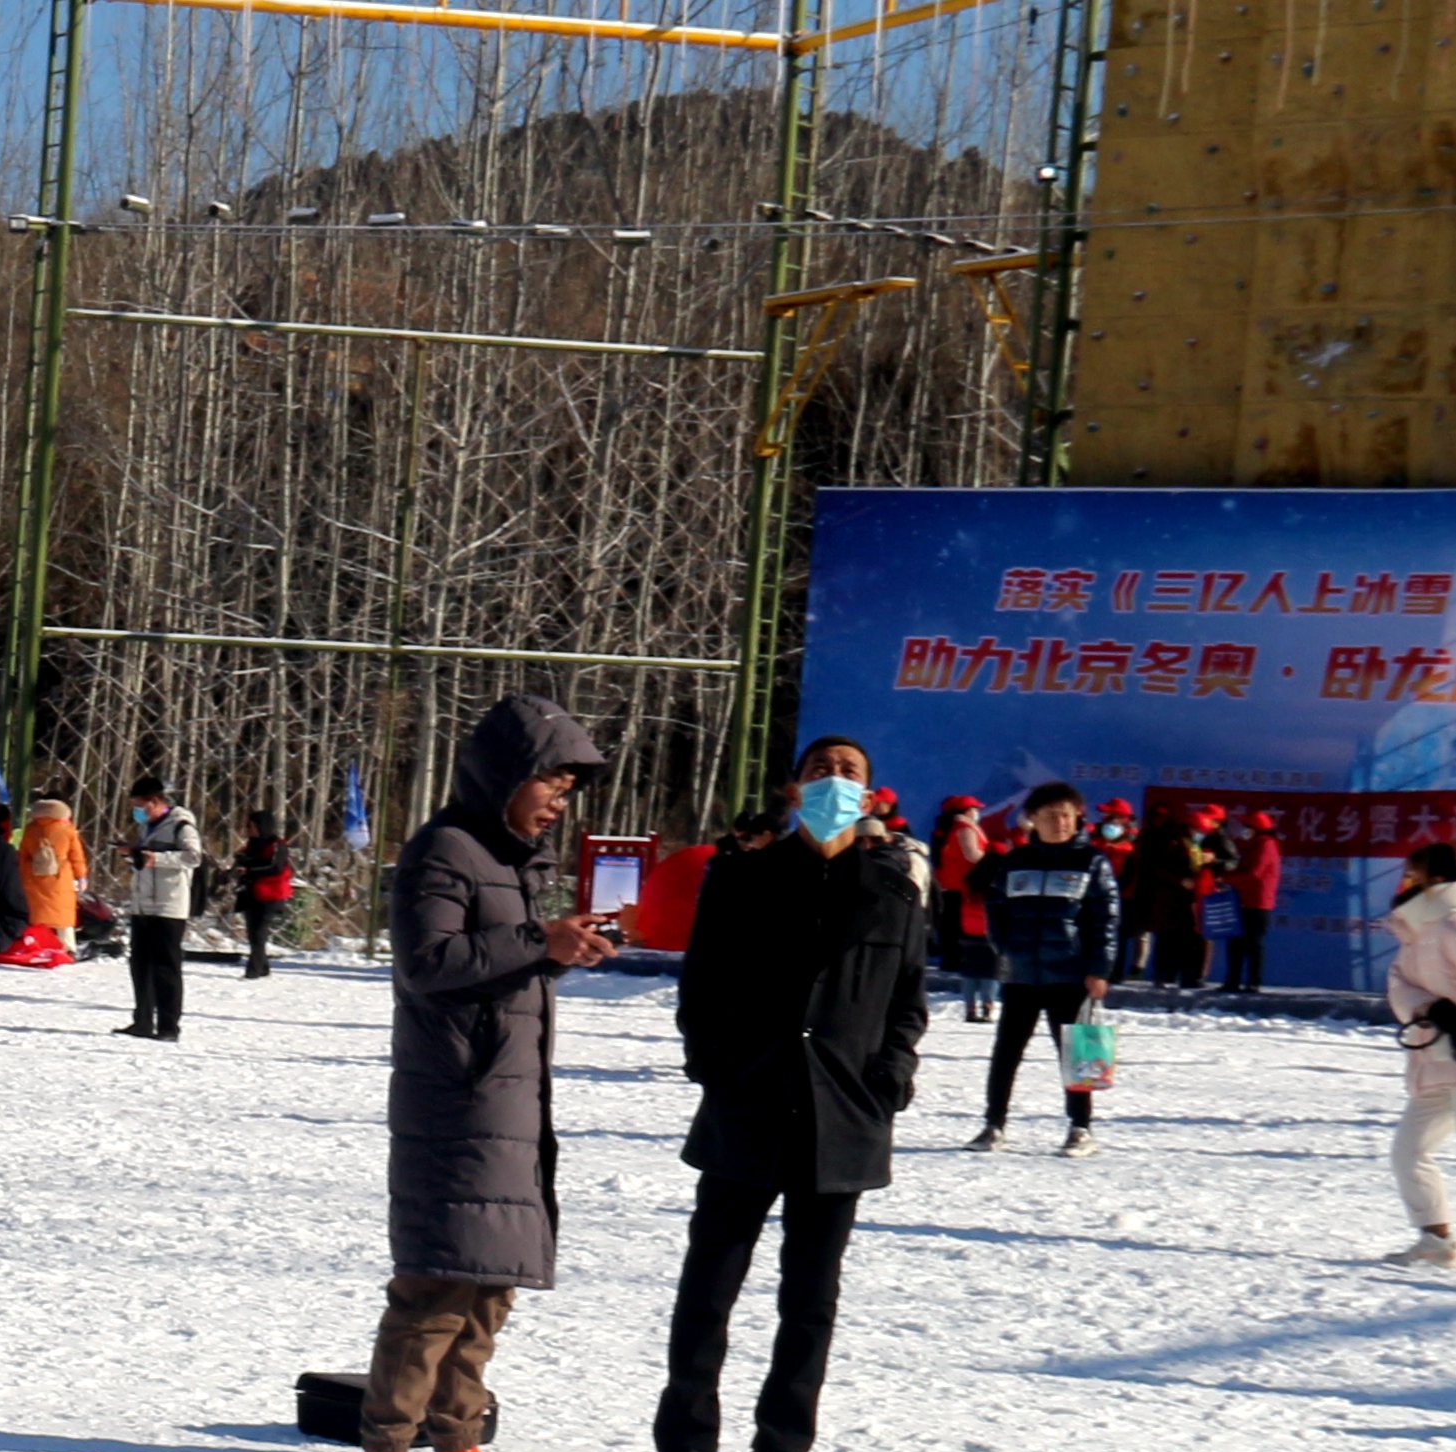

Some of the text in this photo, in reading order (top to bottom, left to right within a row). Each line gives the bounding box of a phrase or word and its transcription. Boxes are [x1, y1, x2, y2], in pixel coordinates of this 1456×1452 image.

[995, 568, 1455, 614] 落实《三亿人上冰雪
[894, 636, 1456, 704] 助力北京冬奥·卧龙
